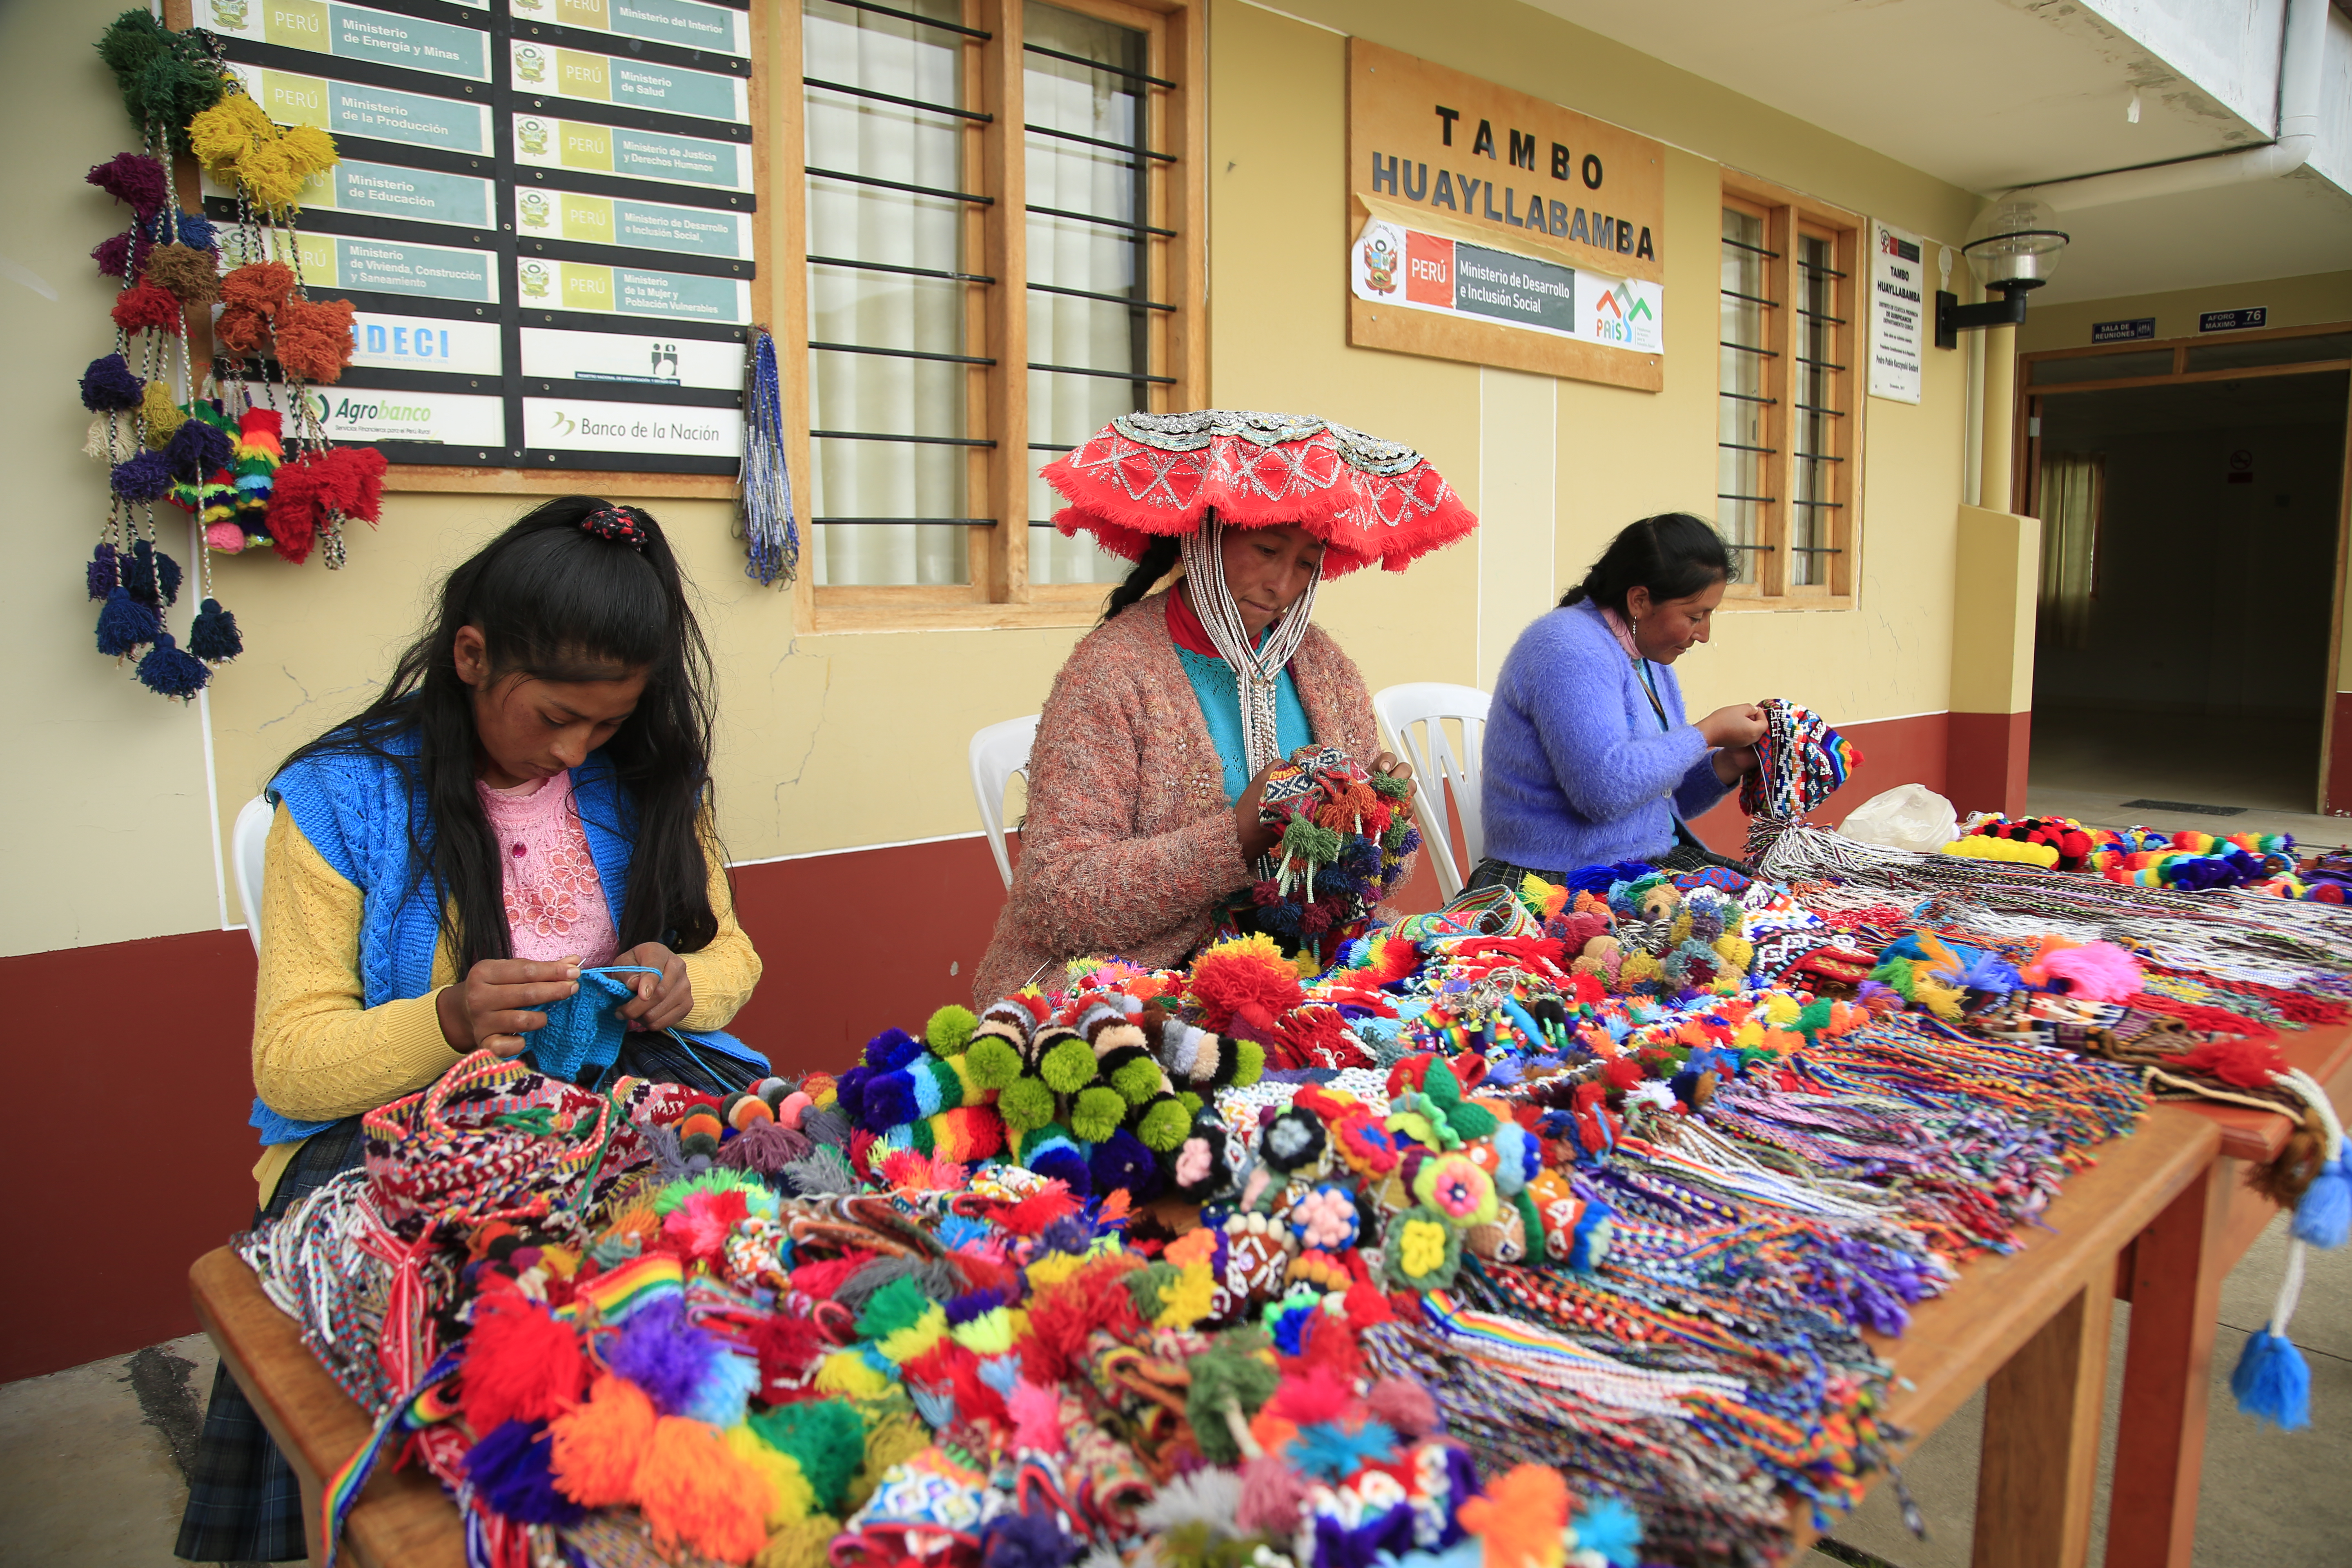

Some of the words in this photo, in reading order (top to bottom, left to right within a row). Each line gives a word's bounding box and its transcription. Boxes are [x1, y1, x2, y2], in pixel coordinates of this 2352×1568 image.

[275, 11, 319, 33] PERÚ
[343, 19, 408, 39] Ministerio
[619, 7, 669, 24] Ministerio
[671, 17, 686, 27] del
[688, 19, 723, 34] Interior
[344, 33, 360, 44] de
[414, 46, 421, 56] y
[424, 46, 459, 60] Minas
[566, 65, 601, 83] PERÚ
[621, 70, 672, 87] Ministerio
[275, 88, 318, 109] PERÚ
[621, 83, 634, 92] de
[636, 85, 664, 97] Salud
[342, 96, 408, 116] Ministerio
[342, 111, 358, 121] de
[362, 113, 373, 123] la
[377, 116, 448, 135] Producción
[569, 137, 604, 154] PERÚ
[623, 140, 668, 155] Ministerio
[669, 147, 681, 156] de
[683, 149, 717, 162] Justicia
[1435, 105, 1603, 190] TAMBO
[624, 154, 629, 163] y
[631, 153, 673, 167] Derechos
[674, 159, 714, 172] Humanos
[348, 174, 414, 192] Ministerio
[349, 188, 365, 198] de
[369, 190, 435, 207] Educación
[1372, 151, 1655, 262] HUAYLLABAMBA
[570, 209, 606, 226] PERÚ
[624, 212, 669, 226] Ministerio
[670, 218, 682, 227] de
[684, 219, 728, 234] Desarrollo
[633, 225, 672, 238] Inclusión
[350, 246, 403, 260] Ministerio
[350, 259, 363, 269] de
[366, 261, 413, 275] Vivienda,
[415, 265, 482, 281] Construcción
[1412, 258, 1446, 283] PERÚ
[1460, 260, 1508, 285] Ministerio
[1510, 272, 1521, 288] de
[1523, 274, 1570, 299] Desarrollo
[1891, 265, 1909, 281] TAMBO
[351, 273, 357, 282] y
[360, 273, 427, 287] Saneamiento
[570, 278, 606, 294] PERÚ
[624, 274, 669, 286] Ministerio
[625, 286, 635, 295] de
[637, 287, 645, 296] la
[647, 288, 671, 299] Mujer
[673, 291, 678, 300] y
[1460, 286, 1466, 298] e
[1468, 284, 1512, 307] Inclusión
[1513, 294, 1541, 314] Social
[1878, 280, 1920, 303] HUAYLLABAMBA
[625, 297, 668, 309] Población
[670, 301, 719, 314] Vulnerables
[2208, 313, 2234, 321] AFORO
[2246, 310, 2261, 321] 76
[2096, 330, 2135, 340] REUNIONES
[335, 399, 430, 424] Agrobanco
[581, 418, 626, 436] Banco
[631, 421, 647, 437] de
[653, 422, 665, 438] la
[671, 423, 719, 441] Nación
